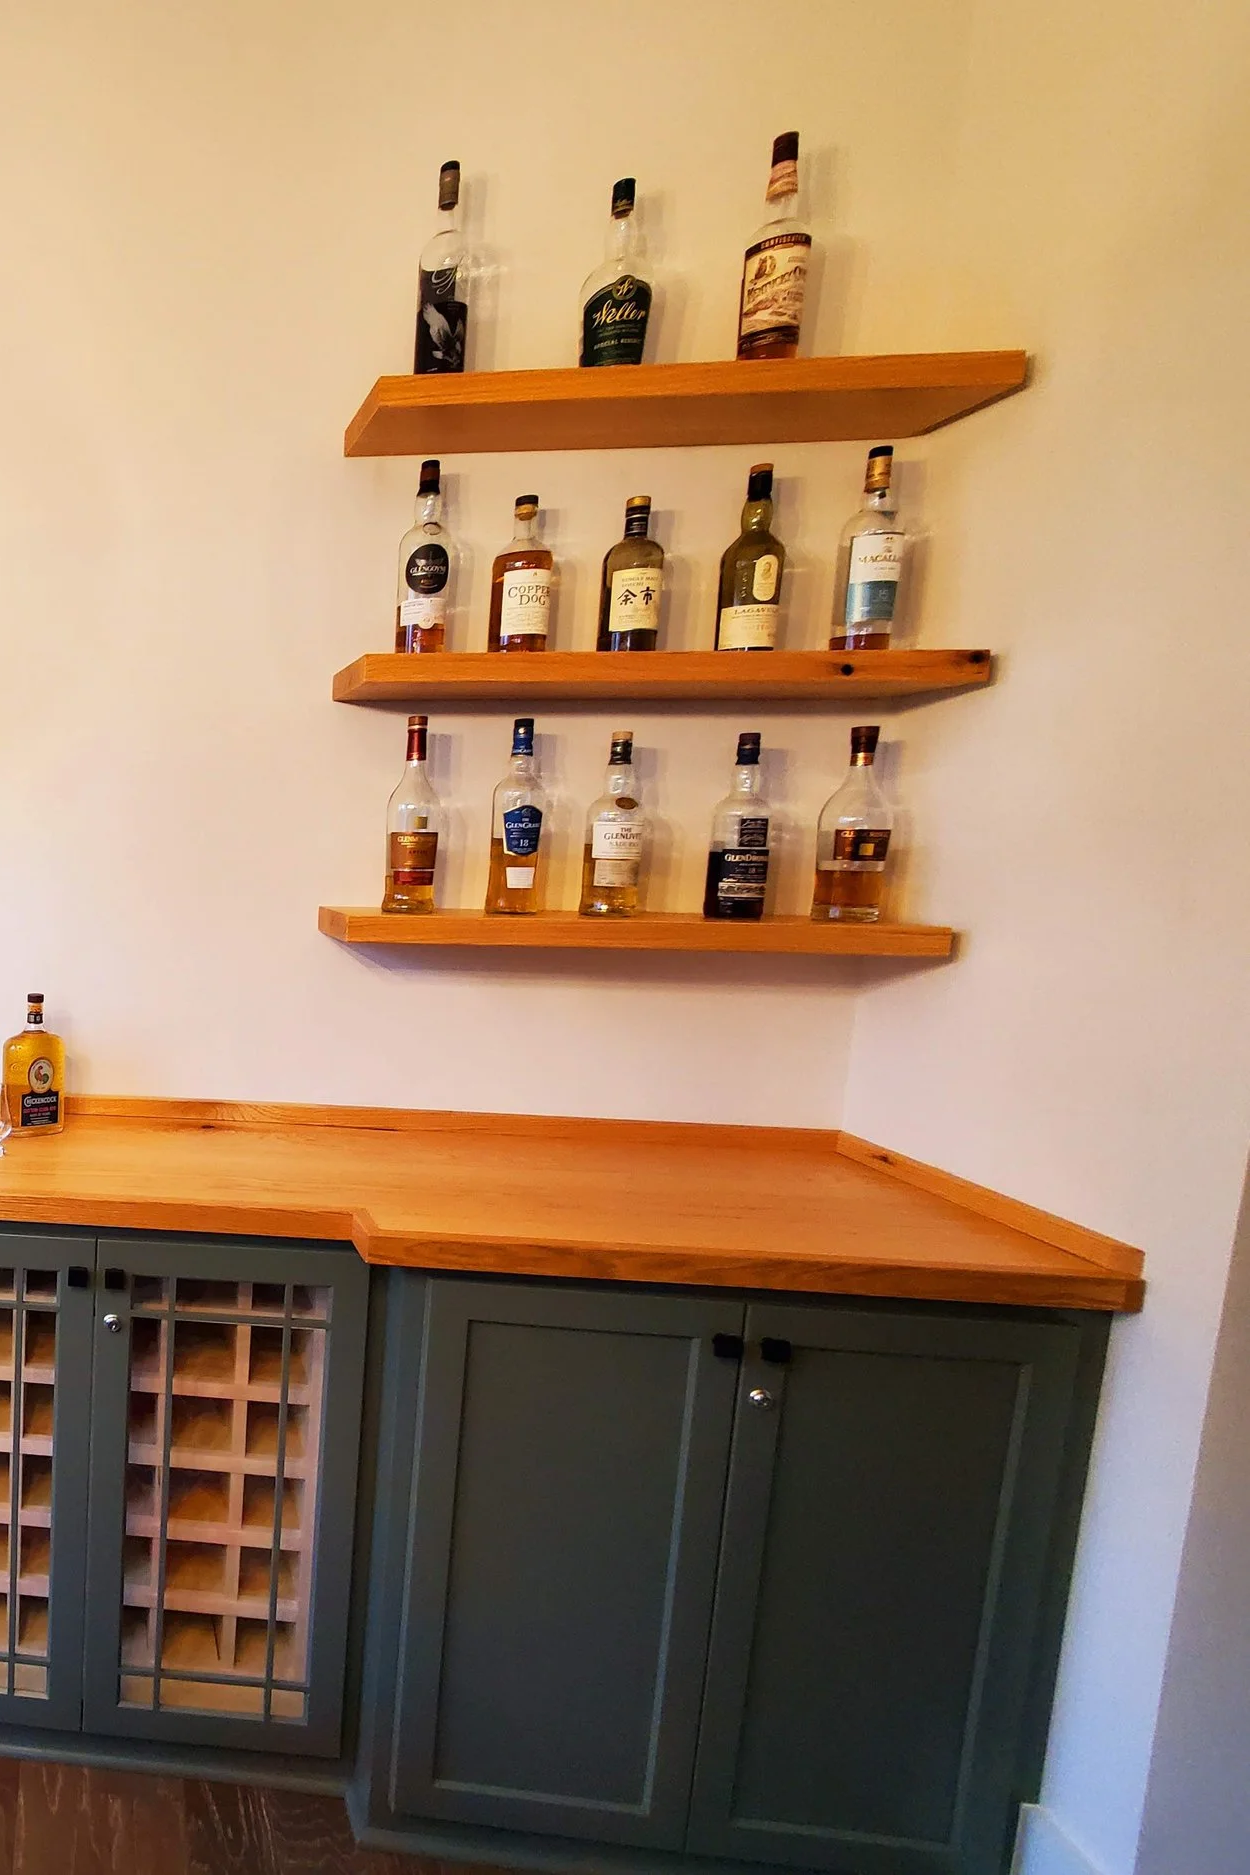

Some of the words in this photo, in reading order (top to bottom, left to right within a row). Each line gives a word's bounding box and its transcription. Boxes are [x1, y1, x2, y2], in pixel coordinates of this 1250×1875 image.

[591, 299, 647, 329] Weller
[518, 594, 547, 606] DOG
[617, 586, 656, 606] 余市
[519, 838, 529, 847] 18
